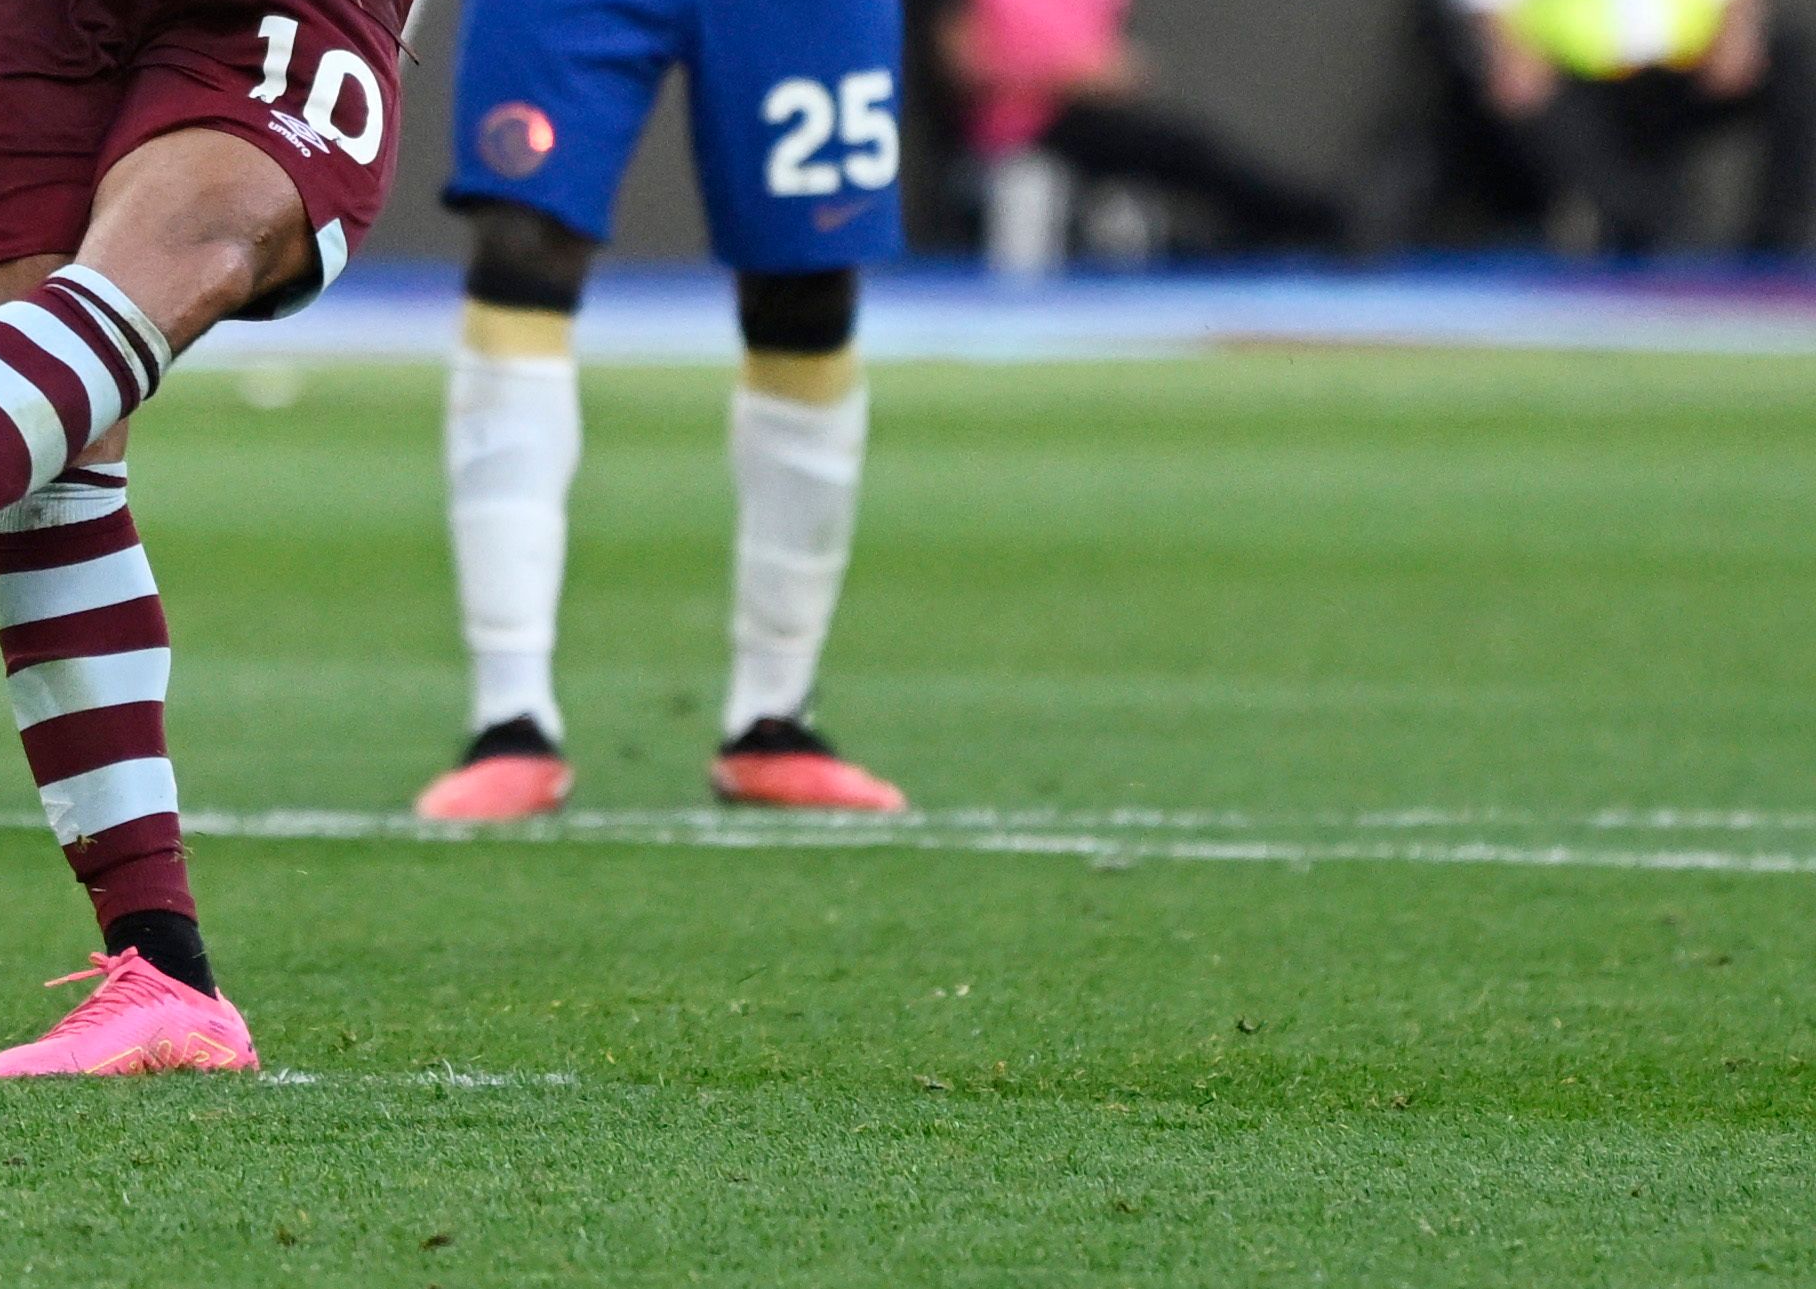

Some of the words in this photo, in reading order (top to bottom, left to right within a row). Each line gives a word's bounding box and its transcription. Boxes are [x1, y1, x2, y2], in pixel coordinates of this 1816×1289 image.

[248, 15, 384, 165] 10
[267, 121, 312, 158] umbro
[761, 69, 900, 198] 25
